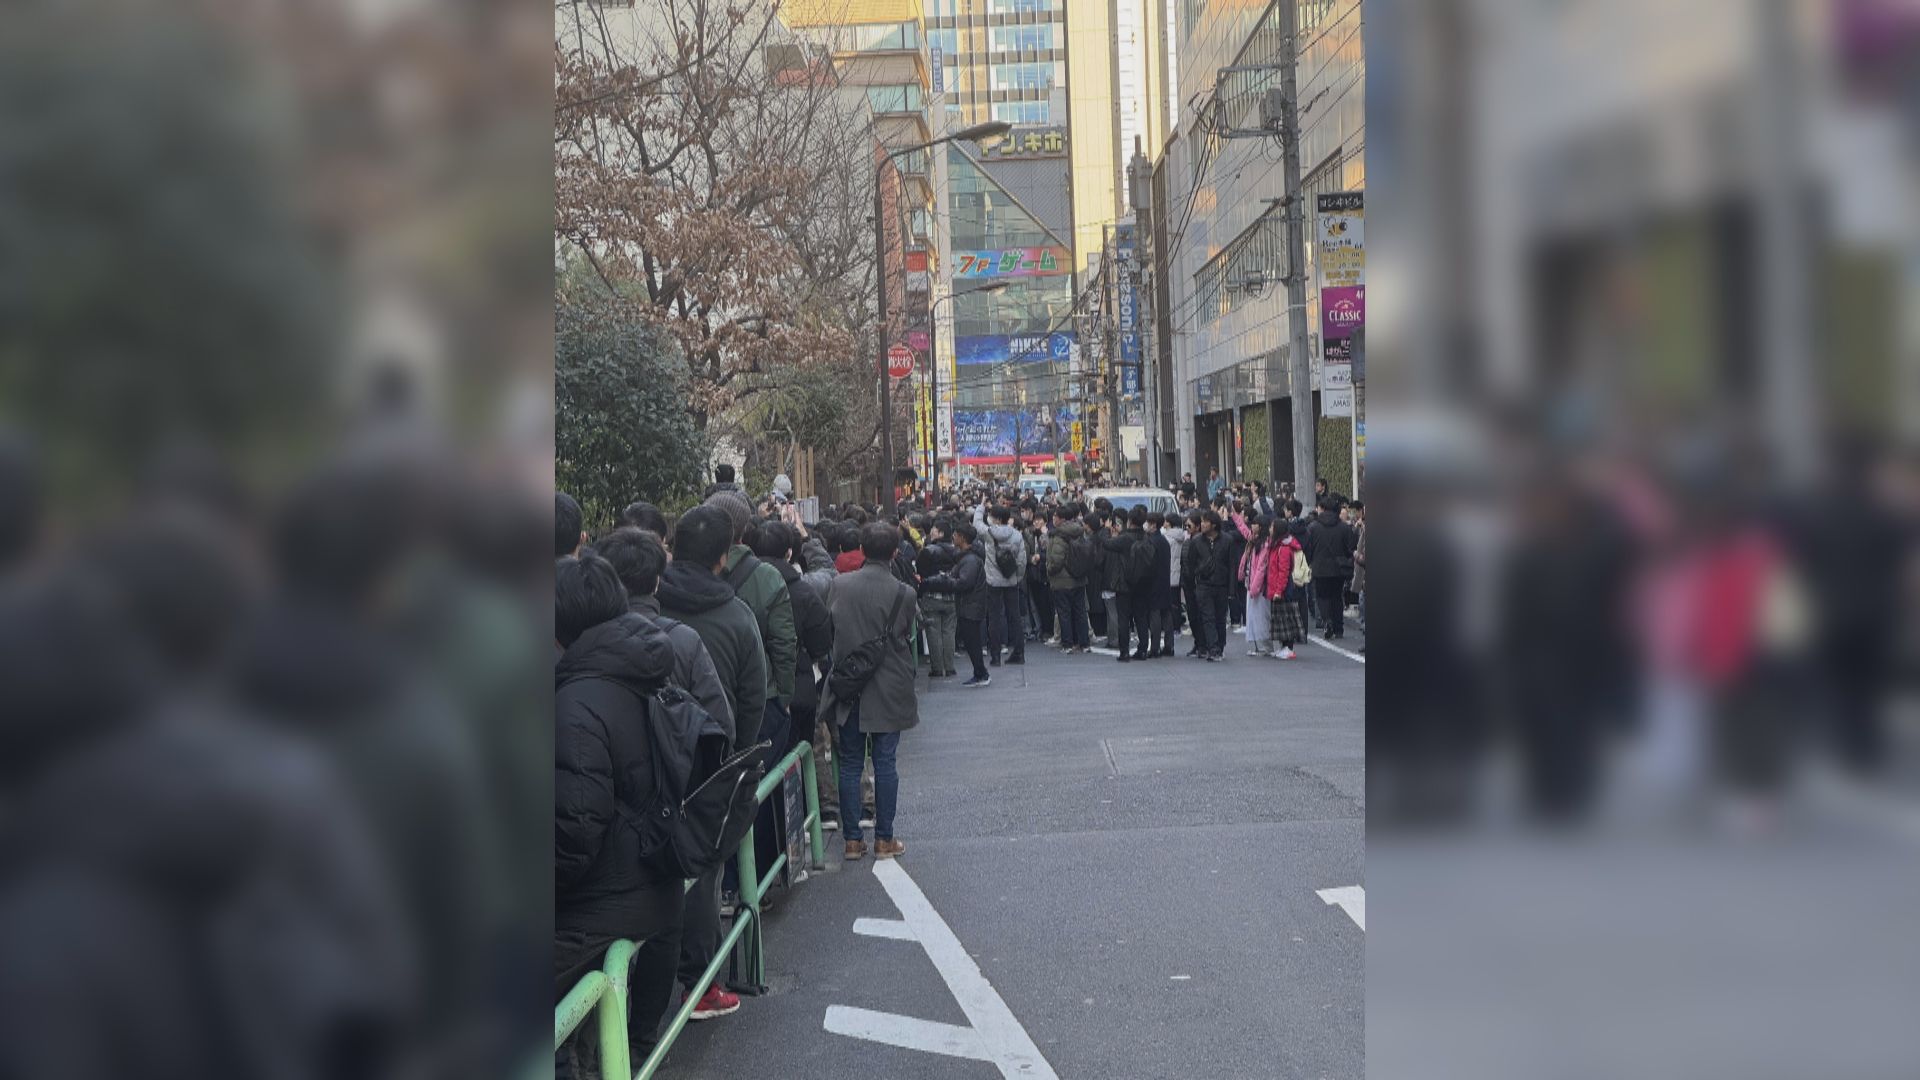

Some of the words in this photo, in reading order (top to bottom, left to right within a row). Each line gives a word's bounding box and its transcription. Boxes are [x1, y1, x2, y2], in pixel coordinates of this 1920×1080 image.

[998, 249, 1057, 273] ゲーム
[1329, 310, 1361, 322] CLASSIC
